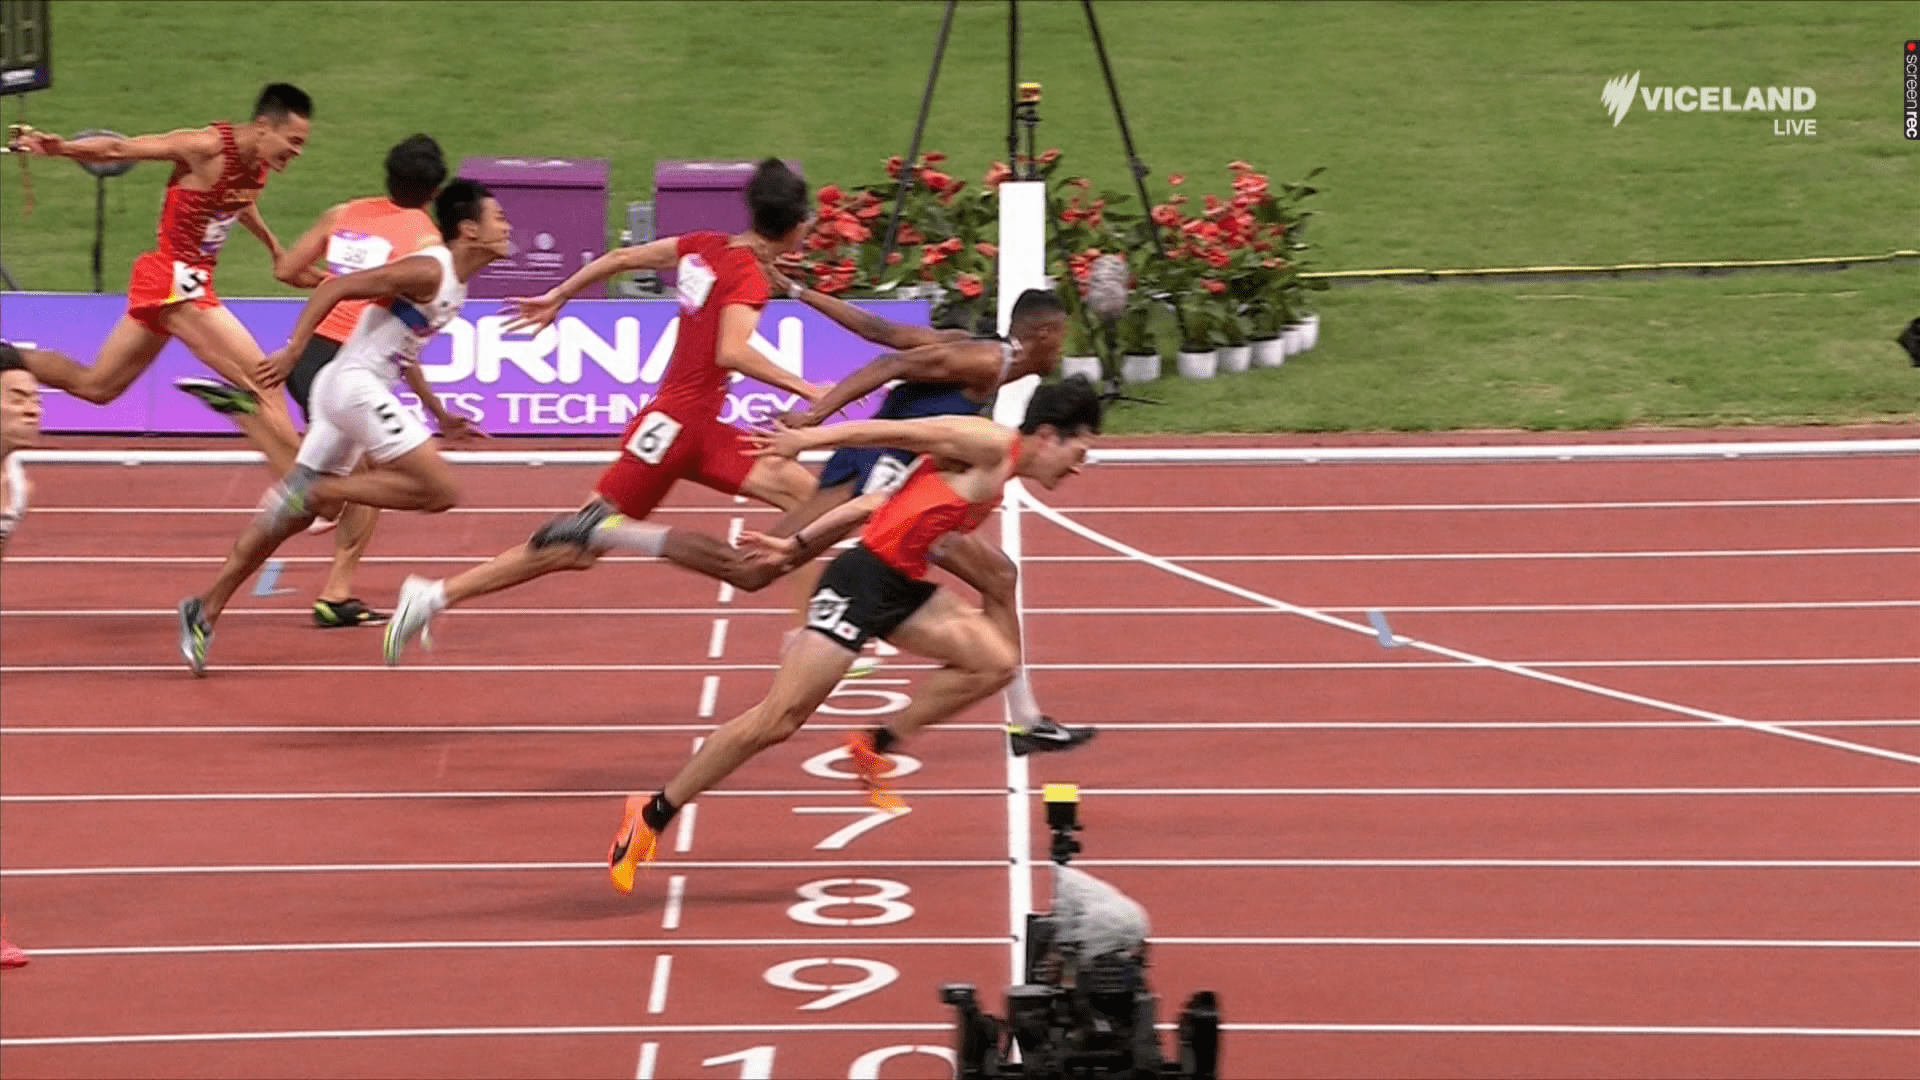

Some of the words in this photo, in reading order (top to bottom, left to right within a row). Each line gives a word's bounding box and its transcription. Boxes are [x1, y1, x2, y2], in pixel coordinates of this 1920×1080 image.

[637, 422, 666, 453] 6
[815, 679, 912, 715] 5
[792, 806, 912, 850] 7
[786, 878, 915, 926] 8
[762, 957, 899, 1010] 9
